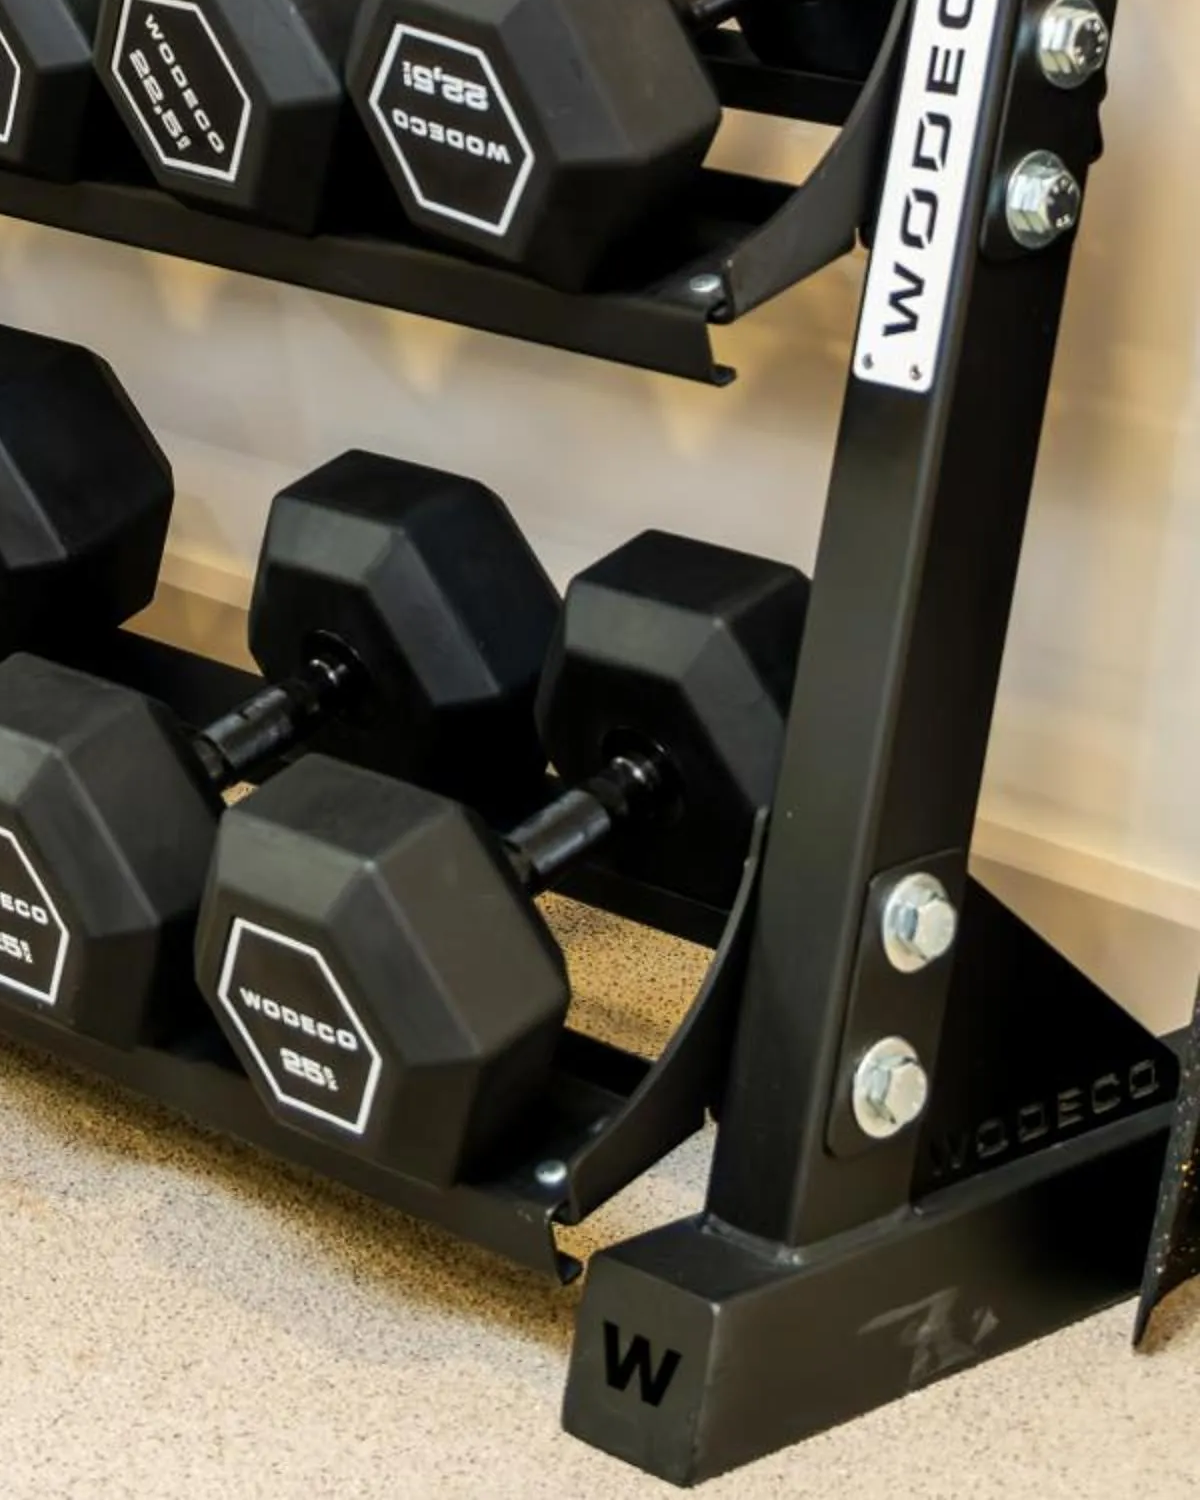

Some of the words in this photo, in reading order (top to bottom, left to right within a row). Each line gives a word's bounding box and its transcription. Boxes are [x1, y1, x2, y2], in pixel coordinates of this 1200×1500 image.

[145, 13, 225, 154] WODECO
[392, 108, 511, 165] WODECO
[239, 987, 359, 1052] WODECO
[603, 1321, 682, 1408] W
